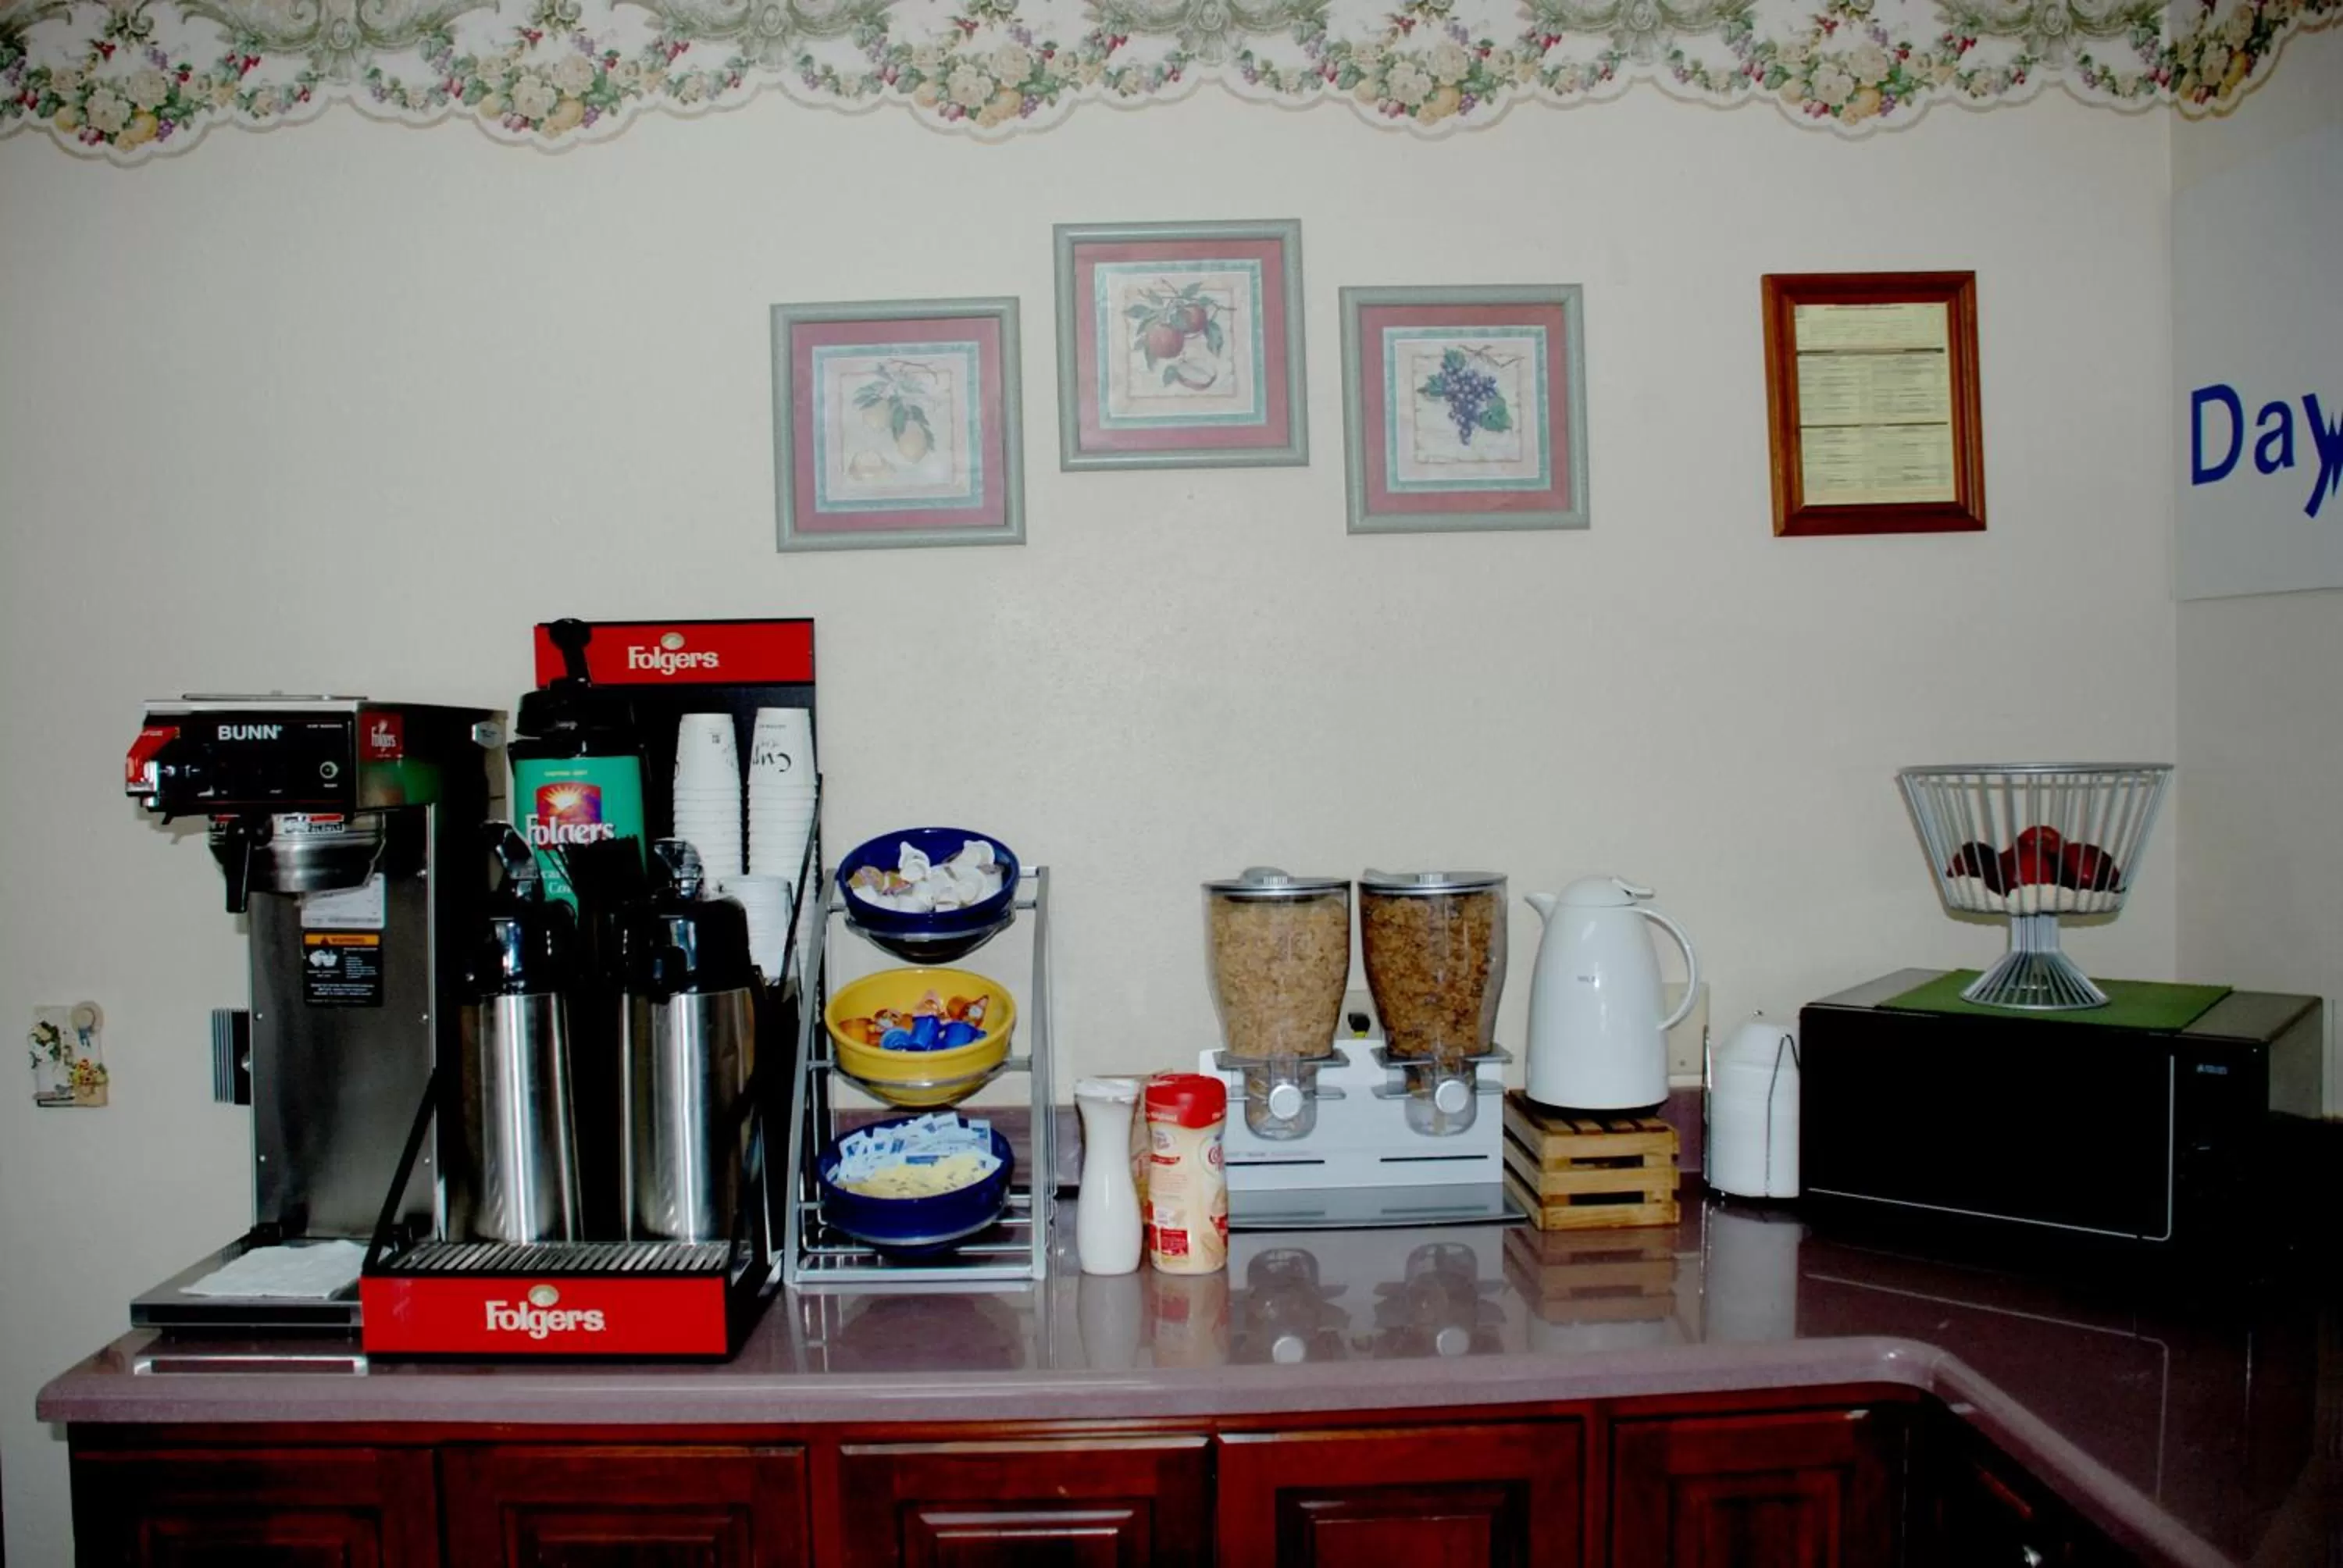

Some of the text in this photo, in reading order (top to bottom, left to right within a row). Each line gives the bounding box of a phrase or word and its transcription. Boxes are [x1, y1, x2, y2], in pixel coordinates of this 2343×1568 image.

[628, 646, 719, 675] Folgers
[218, 724, 279, 740] BUNN
[485, 1300, 605, 1339] Folgers
